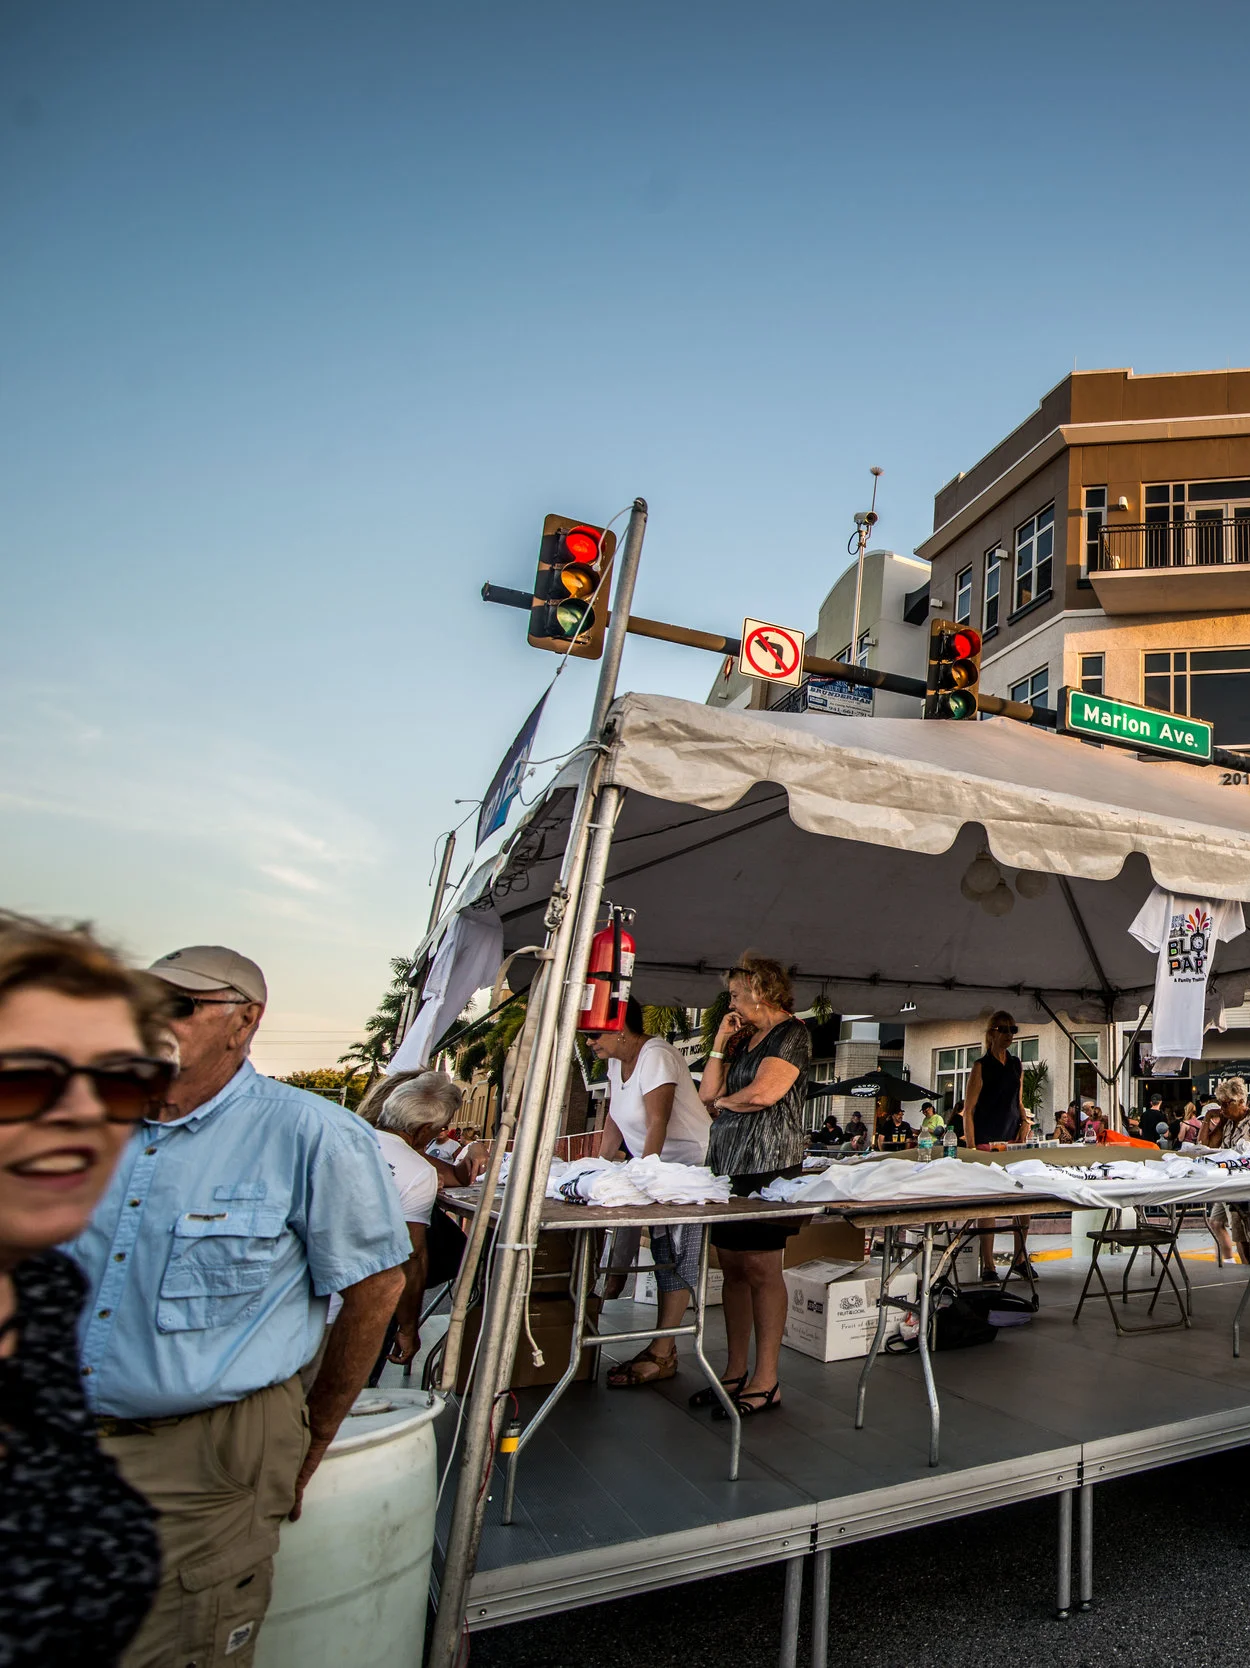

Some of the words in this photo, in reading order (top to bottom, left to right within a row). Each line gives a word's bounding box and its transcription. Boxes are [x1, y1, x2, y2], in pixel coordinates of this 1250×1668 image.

[810, 687, 871, 704] BRUNDERMAN
[1083, 703, 1150, 736] Marion
[1159, 723, 1199, 748] Ave.
